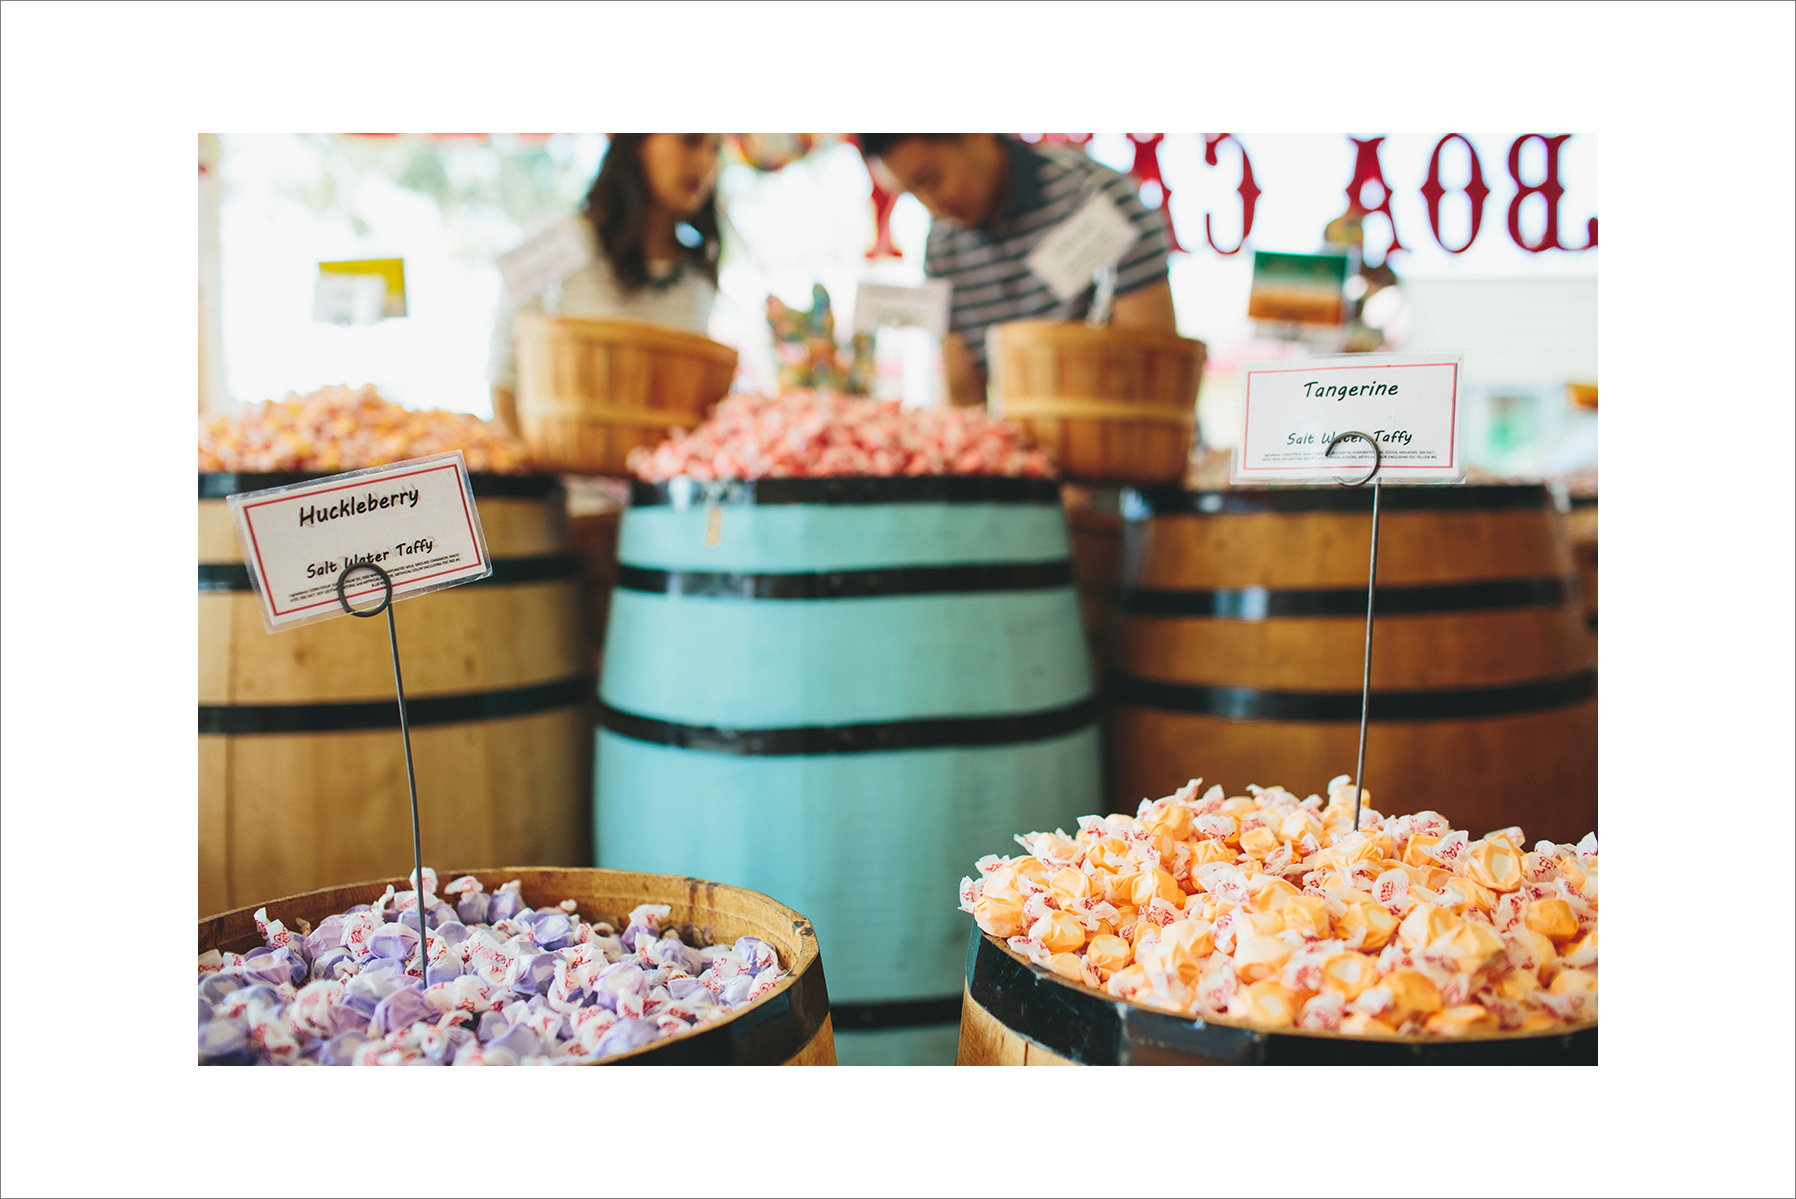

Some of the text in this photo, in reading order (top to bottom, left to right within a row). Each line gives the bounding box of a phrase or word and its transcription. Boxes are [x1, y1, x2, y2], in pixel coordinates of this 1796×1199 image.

[1303, 380, 1399, 402] Tangerine
[1286, 430, 1413, 446] Salt Wter Taffy
[299, 488, 420, 527] Huckleberry
[306, 560, 338, 579] Salt
[395, 537, 433, 559] Taffy
